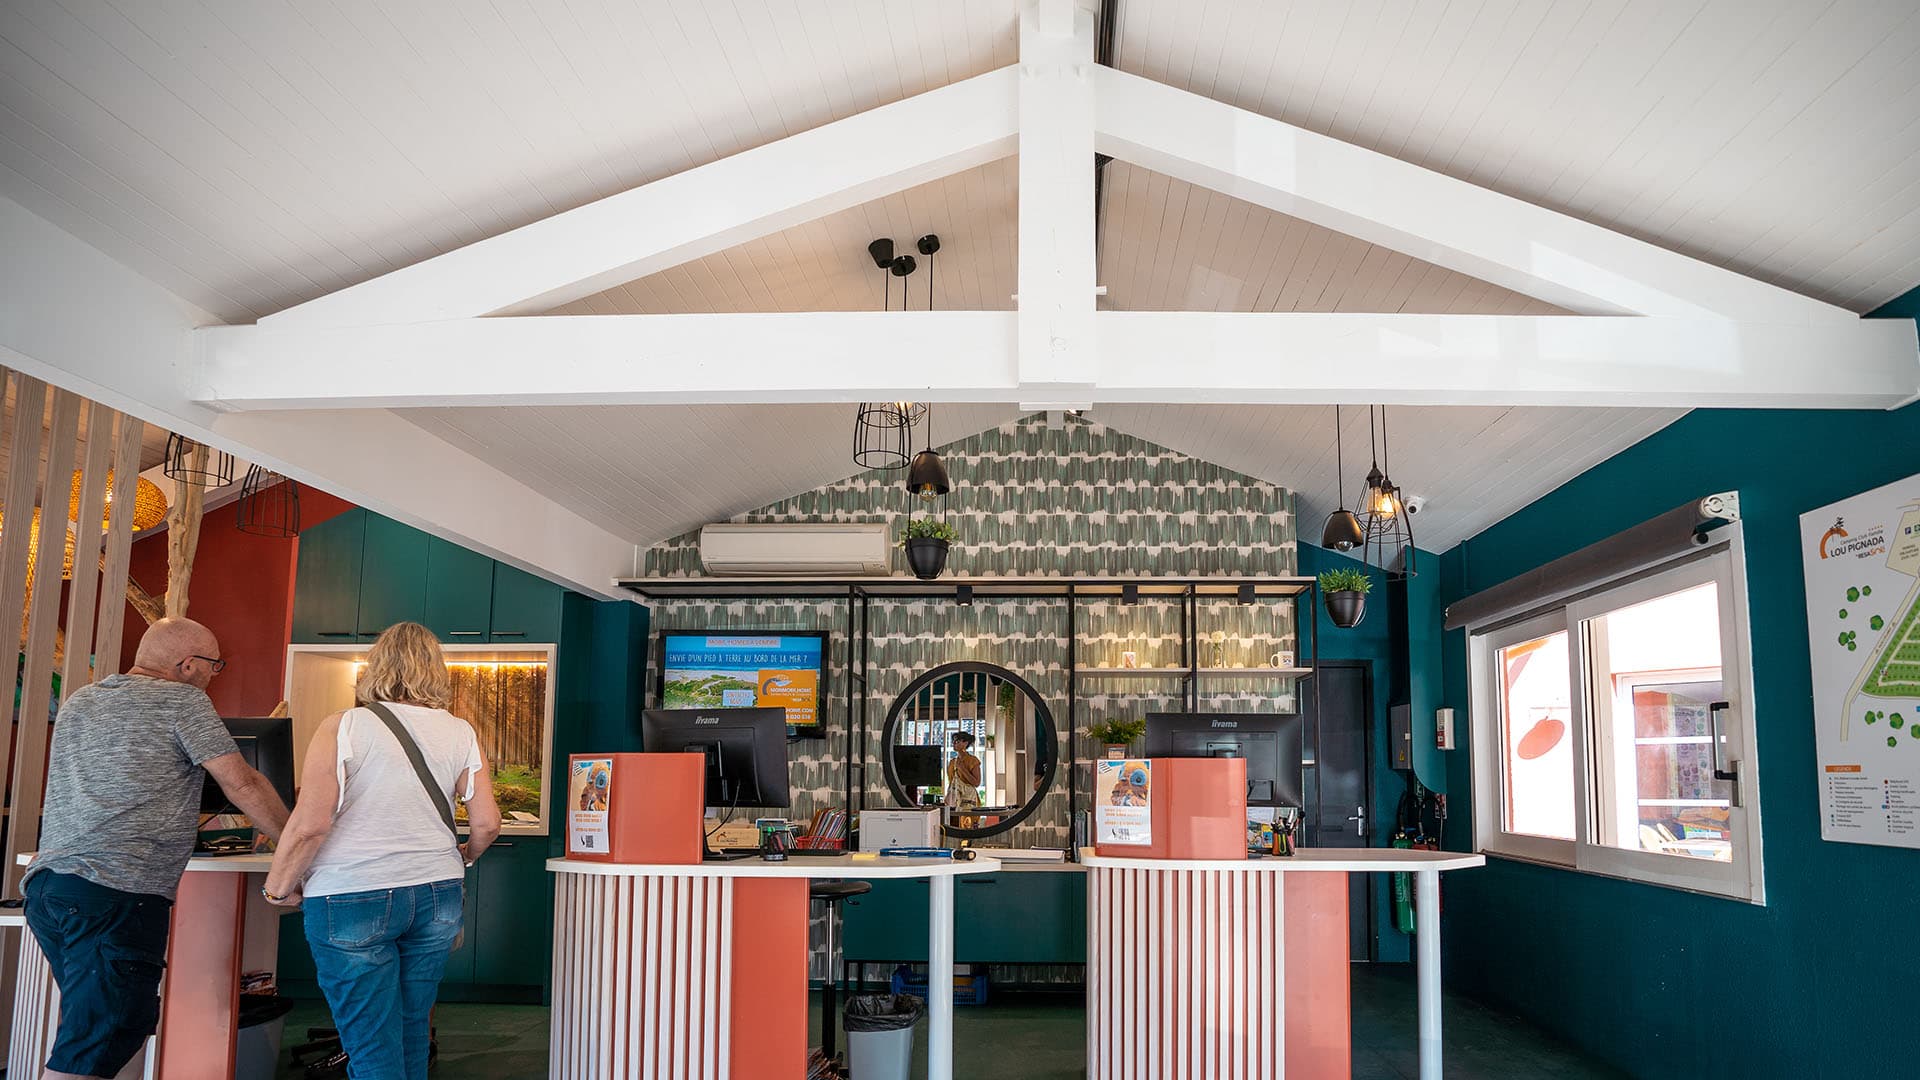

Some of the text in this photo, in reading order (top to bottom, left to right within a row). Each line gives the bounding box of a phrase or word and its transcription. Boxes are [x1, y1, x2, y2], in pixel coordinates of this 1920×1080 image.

[1831, 546, 1846, 557] LOU
[1848, 536, 1885, 552] PIGNADA
[669, 654, 686, 663] ENVIE
[688, 654, 702, 663] D'UN
[704, 654, 716, 663] PIED
[726, 654, 741, 663] TERRE
[744, 654, 752, 663] AU
[754, 654, 768, 663] BORD
[771, 654, 778, 663] DE
[780, 654, 787, 663] LA
[789, 654, 802, 663] MER
[803, 654, 808, 663] ?
[695, 716, 720, 725] iiyama
[1211, 719, 1238, 728] iiyama
